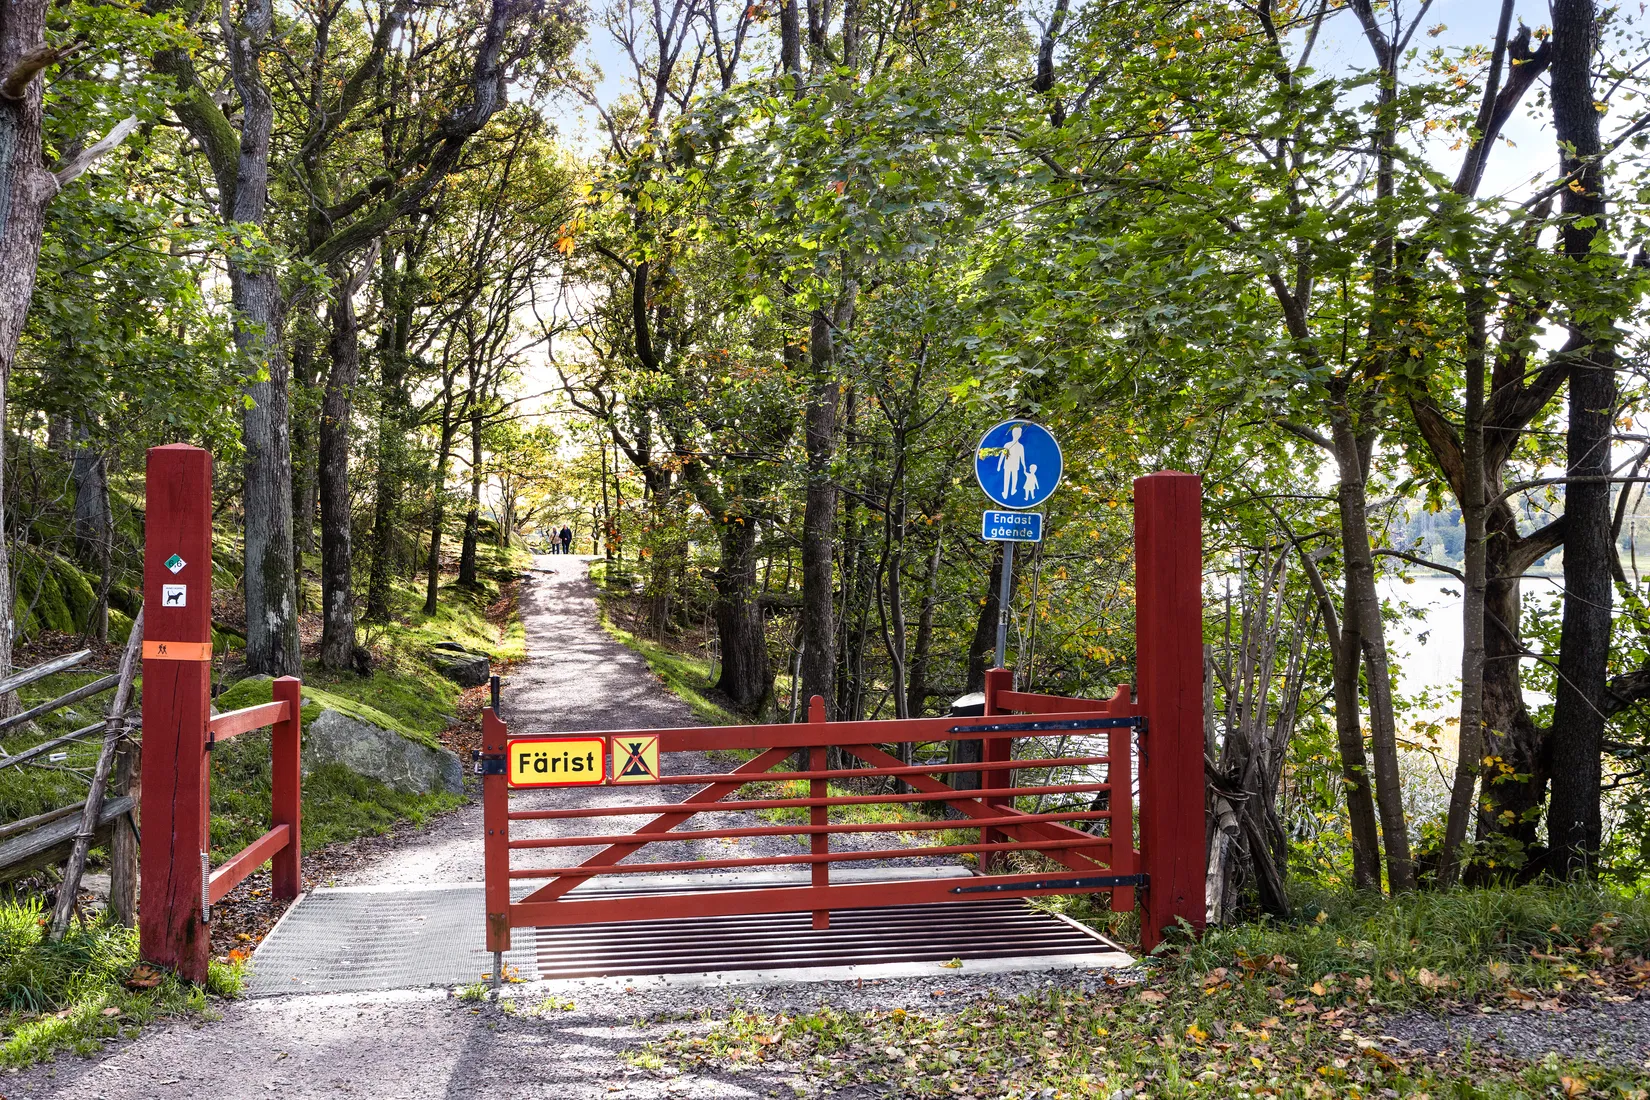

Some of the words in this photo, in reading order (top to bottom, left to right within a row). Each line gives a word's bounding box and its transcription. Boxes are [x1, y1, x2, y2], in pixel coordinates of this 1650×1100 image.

[994, 513, 1031, 525] Endast
[991, 526, 1033, 538] gående
[519, 751, 594, 774] Färist
